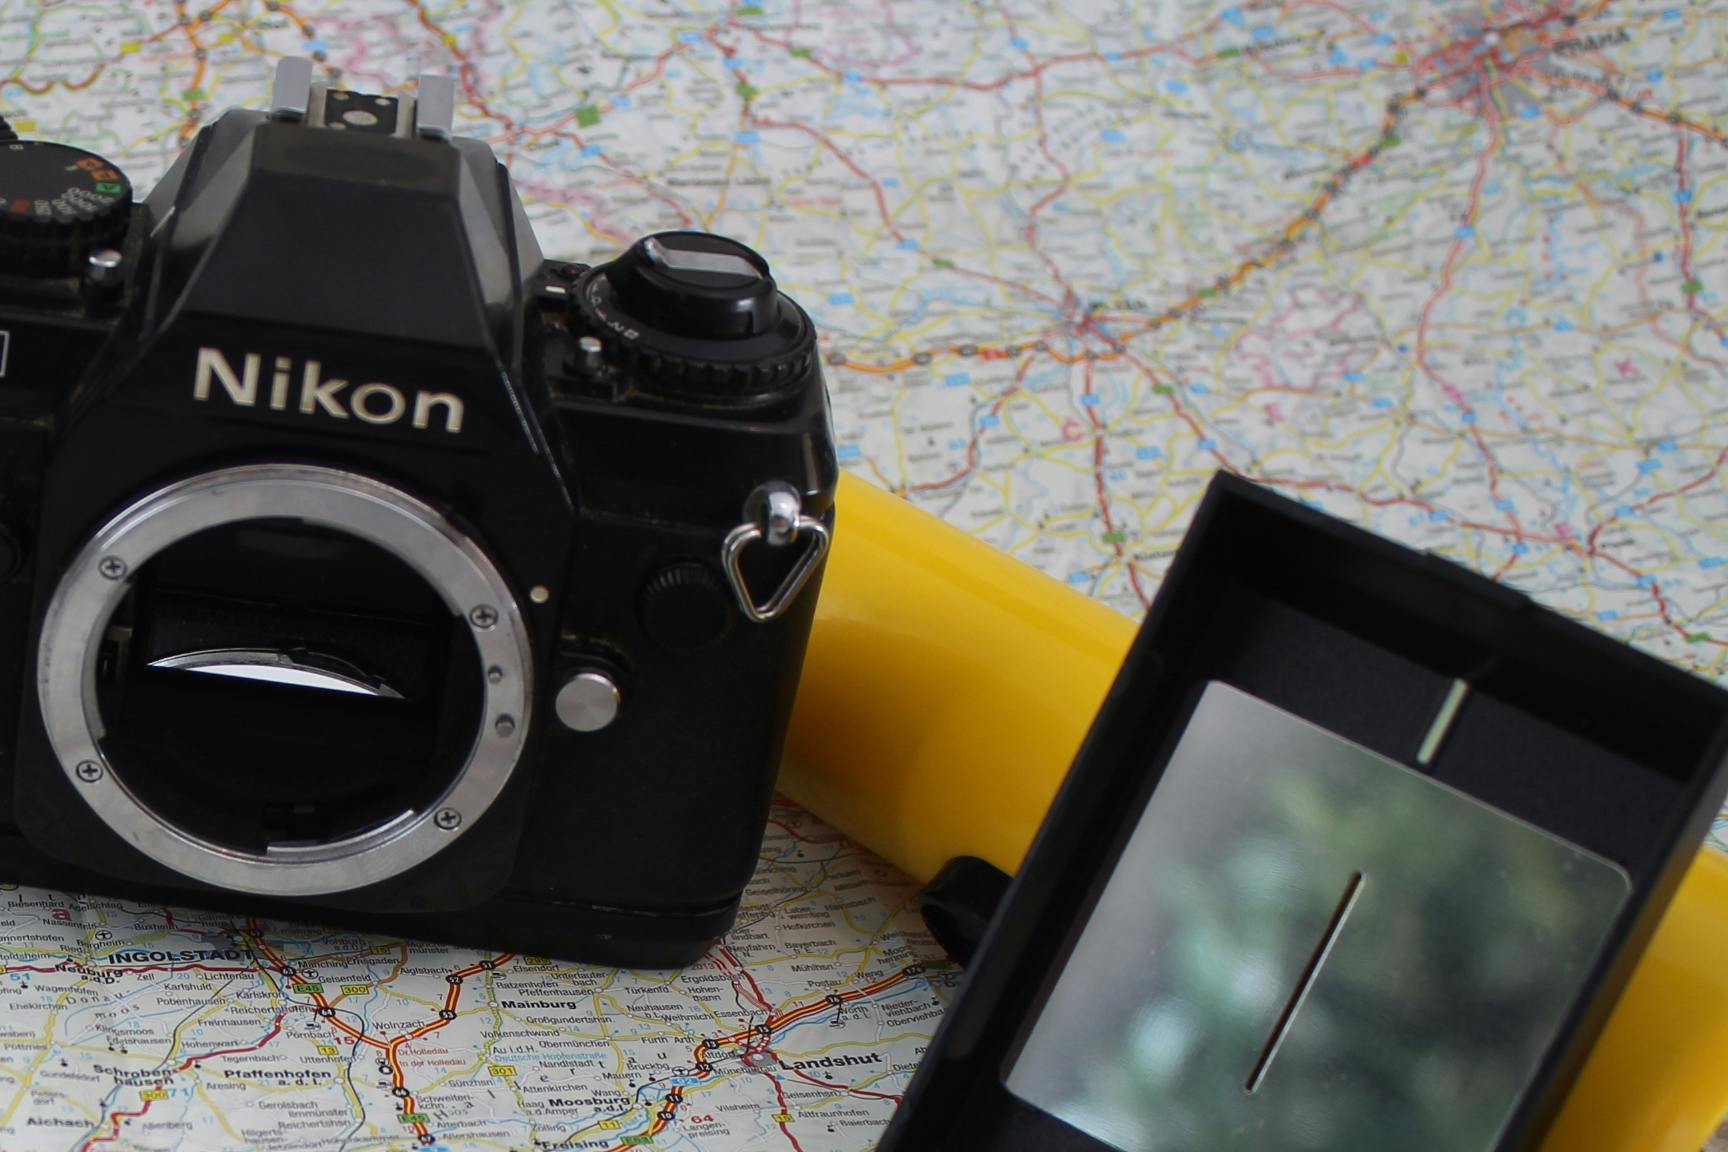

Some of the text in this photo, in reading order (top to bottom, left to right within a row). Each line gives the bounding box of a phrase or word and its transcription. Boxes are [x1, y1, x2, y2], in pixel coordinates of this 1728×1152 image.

[193, 347, 465, 434] Nikon
[108, 950, 255, 963] INGOLSTADT
[502, 999, 577, 1011] Mainburg
[780, 1052, 882, 1070] Landshut
[550, 1096, 630, 1107] Moosburg
